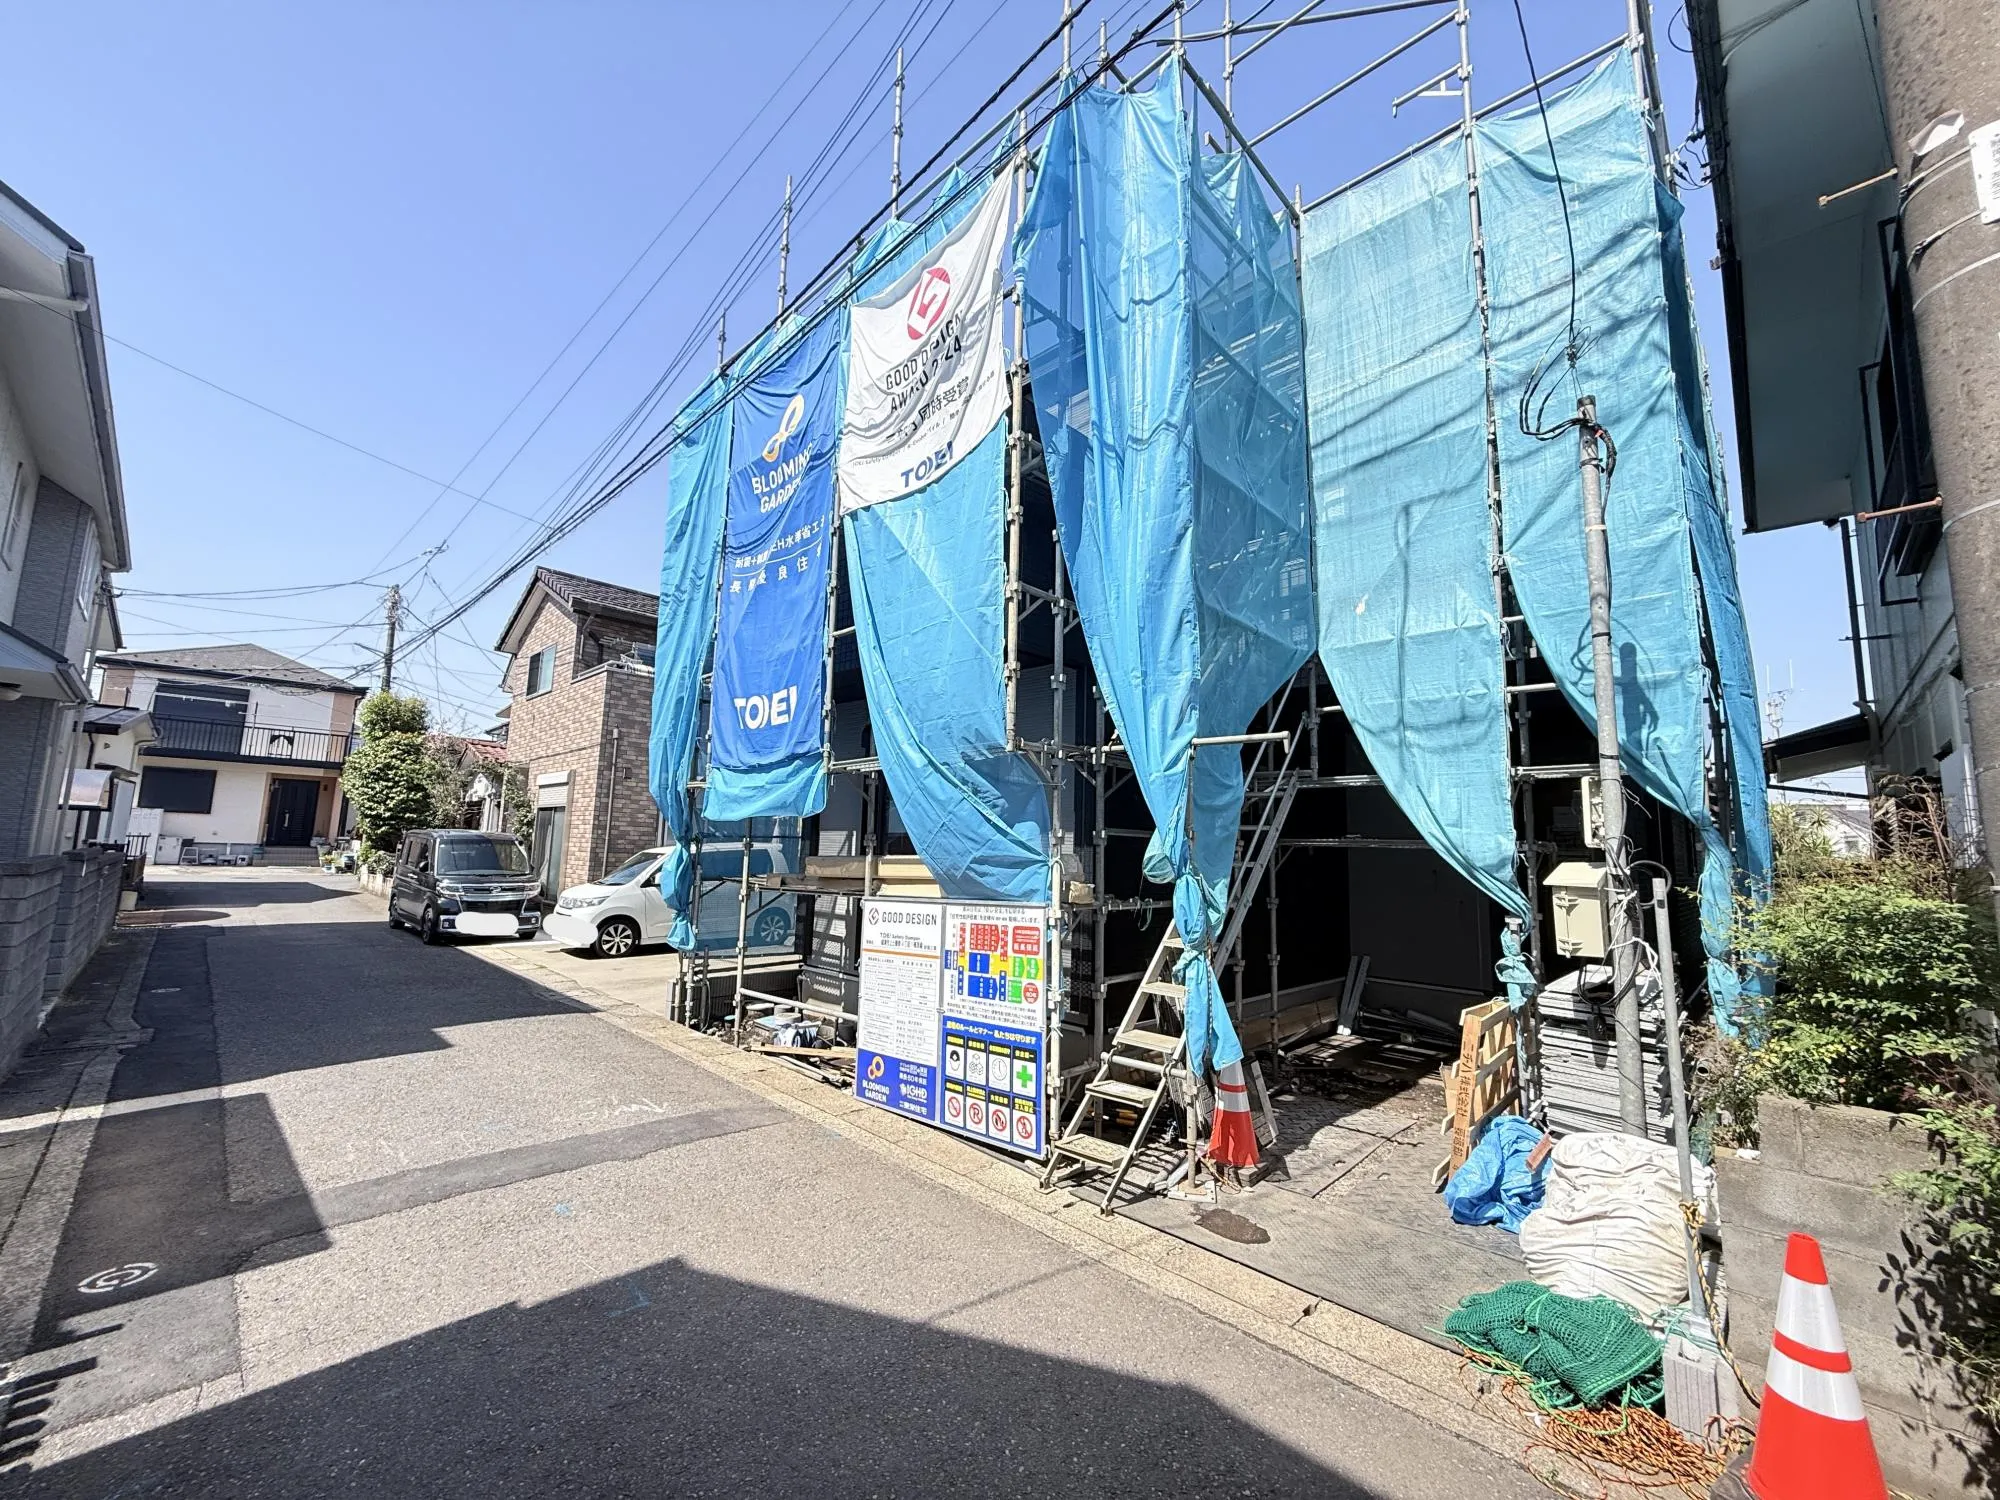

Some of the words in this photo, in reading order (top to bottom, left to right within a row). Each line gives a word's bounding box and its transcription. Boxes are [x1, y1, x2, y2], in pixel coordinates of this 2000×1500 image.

[886, 358, 918, 391] GOOD
[901, 440, 953, 488] TOEI
[760, 477, 801, 513] GARDE
[733, 685, 798, 730] TOEI
[882, 911, 904, 923] GOOD
[905, 912, 937, 926] DESIGN
[862, 1079, 890, 1095] BLOOMING
[865, 1088, 887, 1103] GARDEN
[1456, 1042, 1474, 1118] ニチハ株式会社
